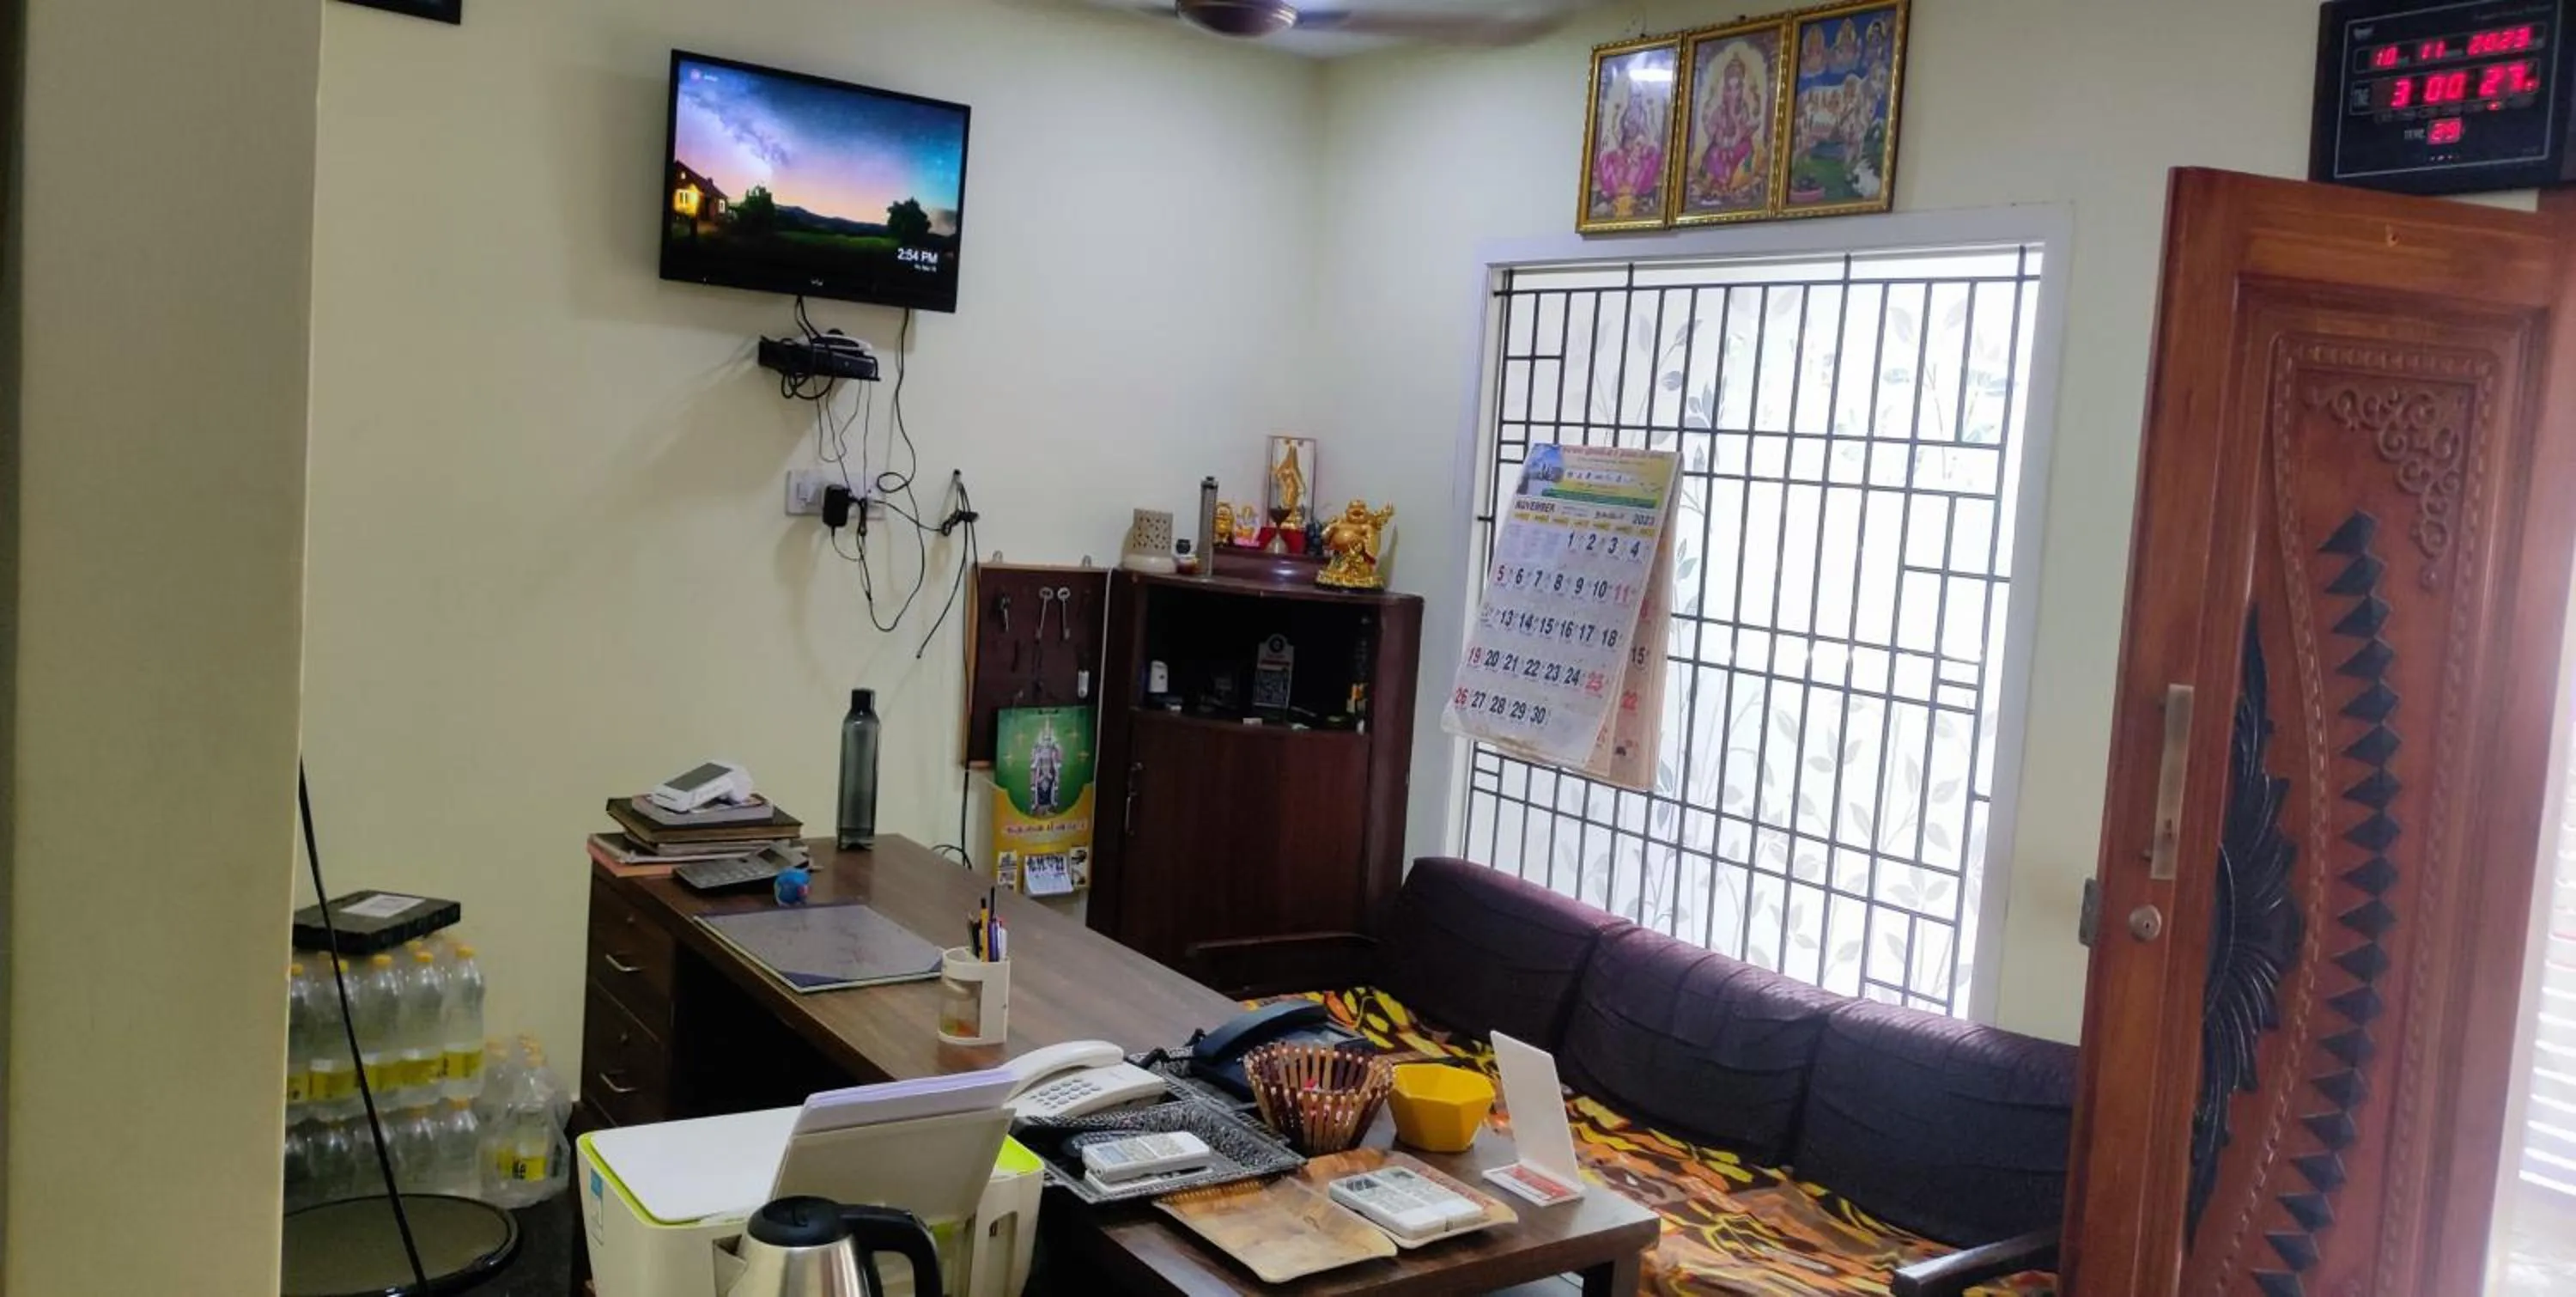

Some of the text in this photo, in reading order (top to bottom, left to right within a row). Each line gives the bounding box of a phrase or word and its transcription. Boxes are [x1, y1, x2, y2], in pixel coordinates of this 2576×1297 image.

[2376, 45, 2398, 67] 10
[2421, 40, 2446, 60] 11
[2467, 27, 2531, 57] 2023
[2391, 78, 2411, 107] 3
[2424, 72, 2466, 102] 00
[896, 247, 939, 265] 2:54 PM
[1514, 500, 1556, 514] NOVEMBER
[1632, 513, 1656, 527] 2023
[1568, 531, 1576, 548] 1
[1586, 533, 1597, 551] 2
[1607, 536, 1619, 554] 3
[1630, 540, 1641, 558] 4
[1497, 565, 1630, 602] 5 6 7 8 9 10 11
[1500, 609, 1618, 648] 13 14 15 16 17 18
[1468, 646, 1481, 665] 19
[1484, 649, 1500, 668] 20
[1503, 654, 1519, 672] 21
[1523, 659, 1540, 678] 22
[1544, 663, 1560, 682] 23
[1564, 667, 1581, 686] 24
[1631, 646, 1646, 665] 15
[1455, 687, 1546, 725] 26 27 28 29 30
